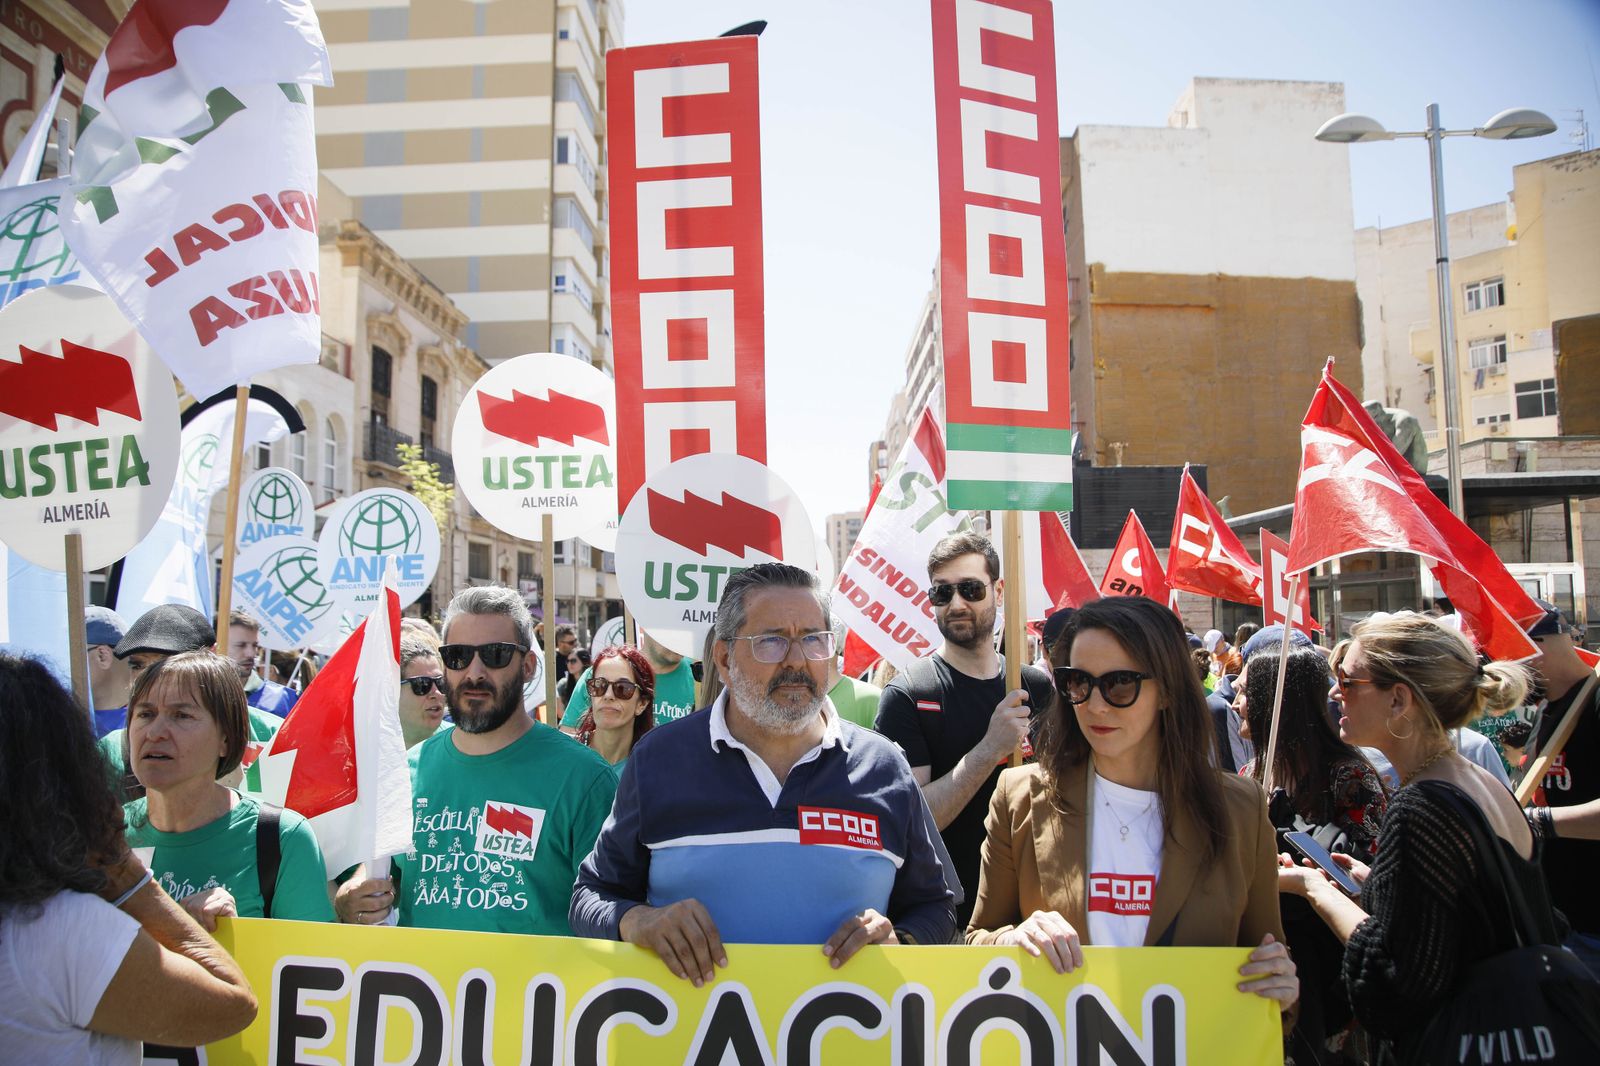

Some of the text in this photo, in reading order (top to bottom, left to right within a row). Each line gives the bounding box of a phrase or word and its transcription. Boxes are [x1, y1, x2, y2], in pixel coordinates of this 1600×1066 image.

[955, 0, 1050, 412] CCOO
[633, 62, 738, 482] CCOO
[0, 434, 151, 500] USTEA
[482, 454, 613, 491] USTEA
[43, 499, 111, 524] ALMERÍA
[521, 494, 578, 509] ALMERÍA
[644, 561, 746, 602] UST
[855, 548, 938, 625] SINDIC
[233, 568, 315, 644] ANPE
[354, 594, 380, 602] ALME
[682, 609, 718, 624] ALME
[414, 811, 474, 836] ESCUELA
[801, 811, 877, 838] CCOO
[482, 834, 533, 857] USTEA
[848, 834, 880, 847] ALMERÍA
[421, 854, 449, 873] DE
[415, 886, 450, 906] ARA
[1090, 877, 1152, 901] COO
[1114, 901, 1151, 911] ALMERÍA
[271, 957, 1185, 1066] EDUCACIÓN
